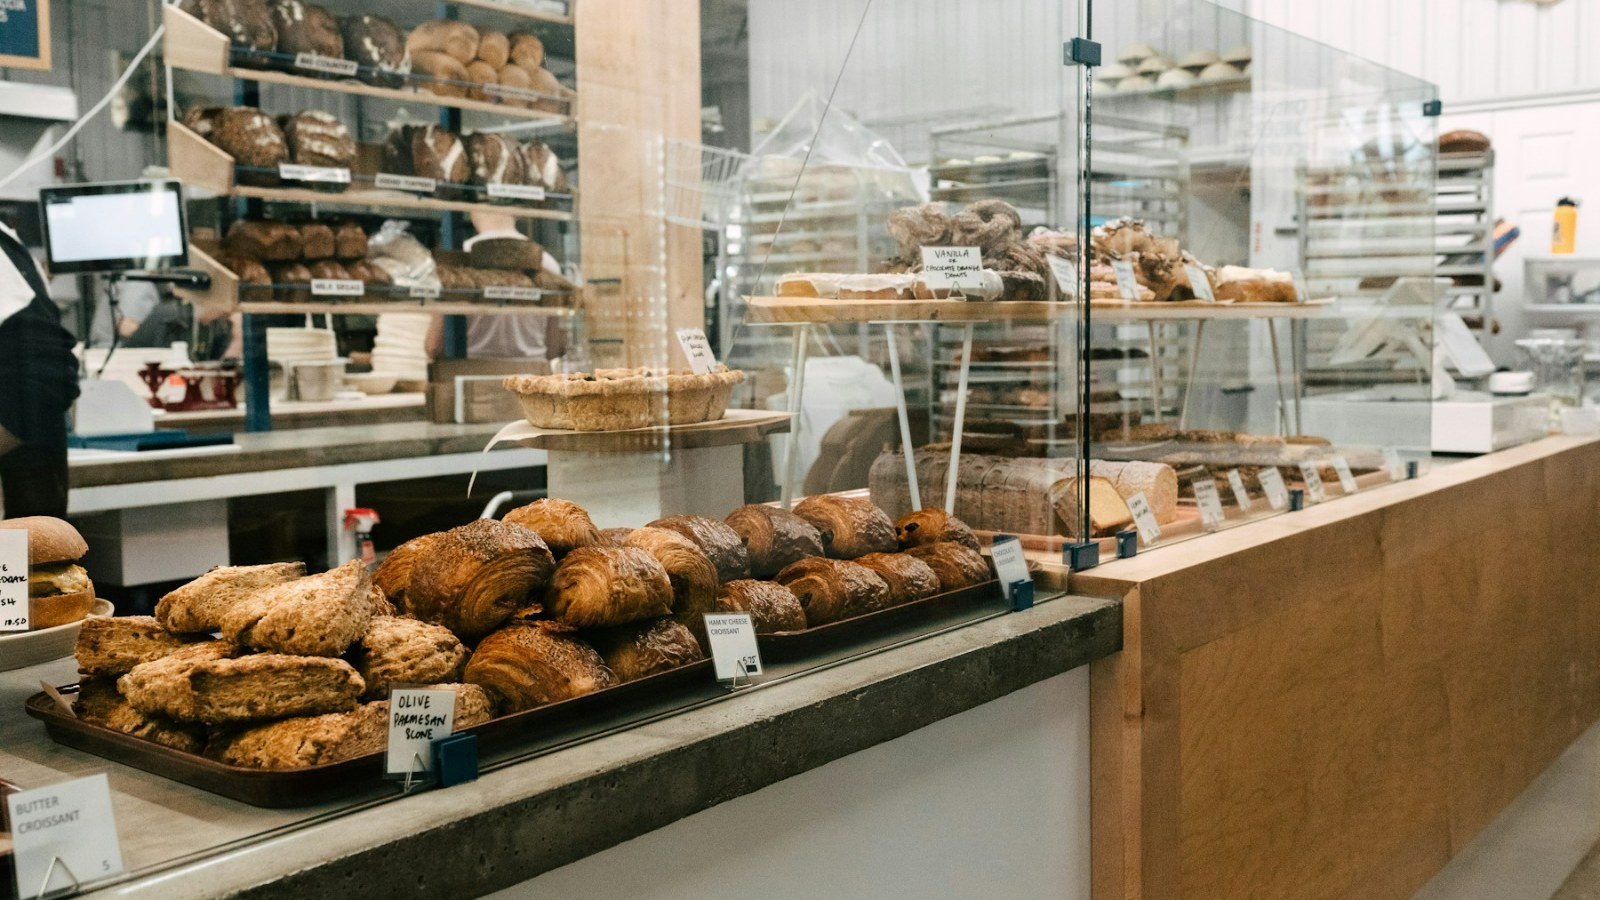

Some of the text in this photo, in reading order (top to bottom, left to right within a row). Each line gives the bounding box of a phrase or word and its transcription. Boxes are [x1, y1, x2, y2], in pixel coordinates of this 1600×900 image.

[934, 249, 969, 259] VANILLA
[709, 618, 722, 626] HAM
[728, 617, 749, 625] CHEESE
[710, 627, 740, 636] CROISSANT
[398, 694, 432, 710] OLIVE
[393, 713, 447, 728] PARMESAN
[405, 728, 434, 741] SCONE
[15, 796, 60, 816] BUTTER
[17, 809, 80, 835] CROISSANT
[102, 859, 111, 871] 5
